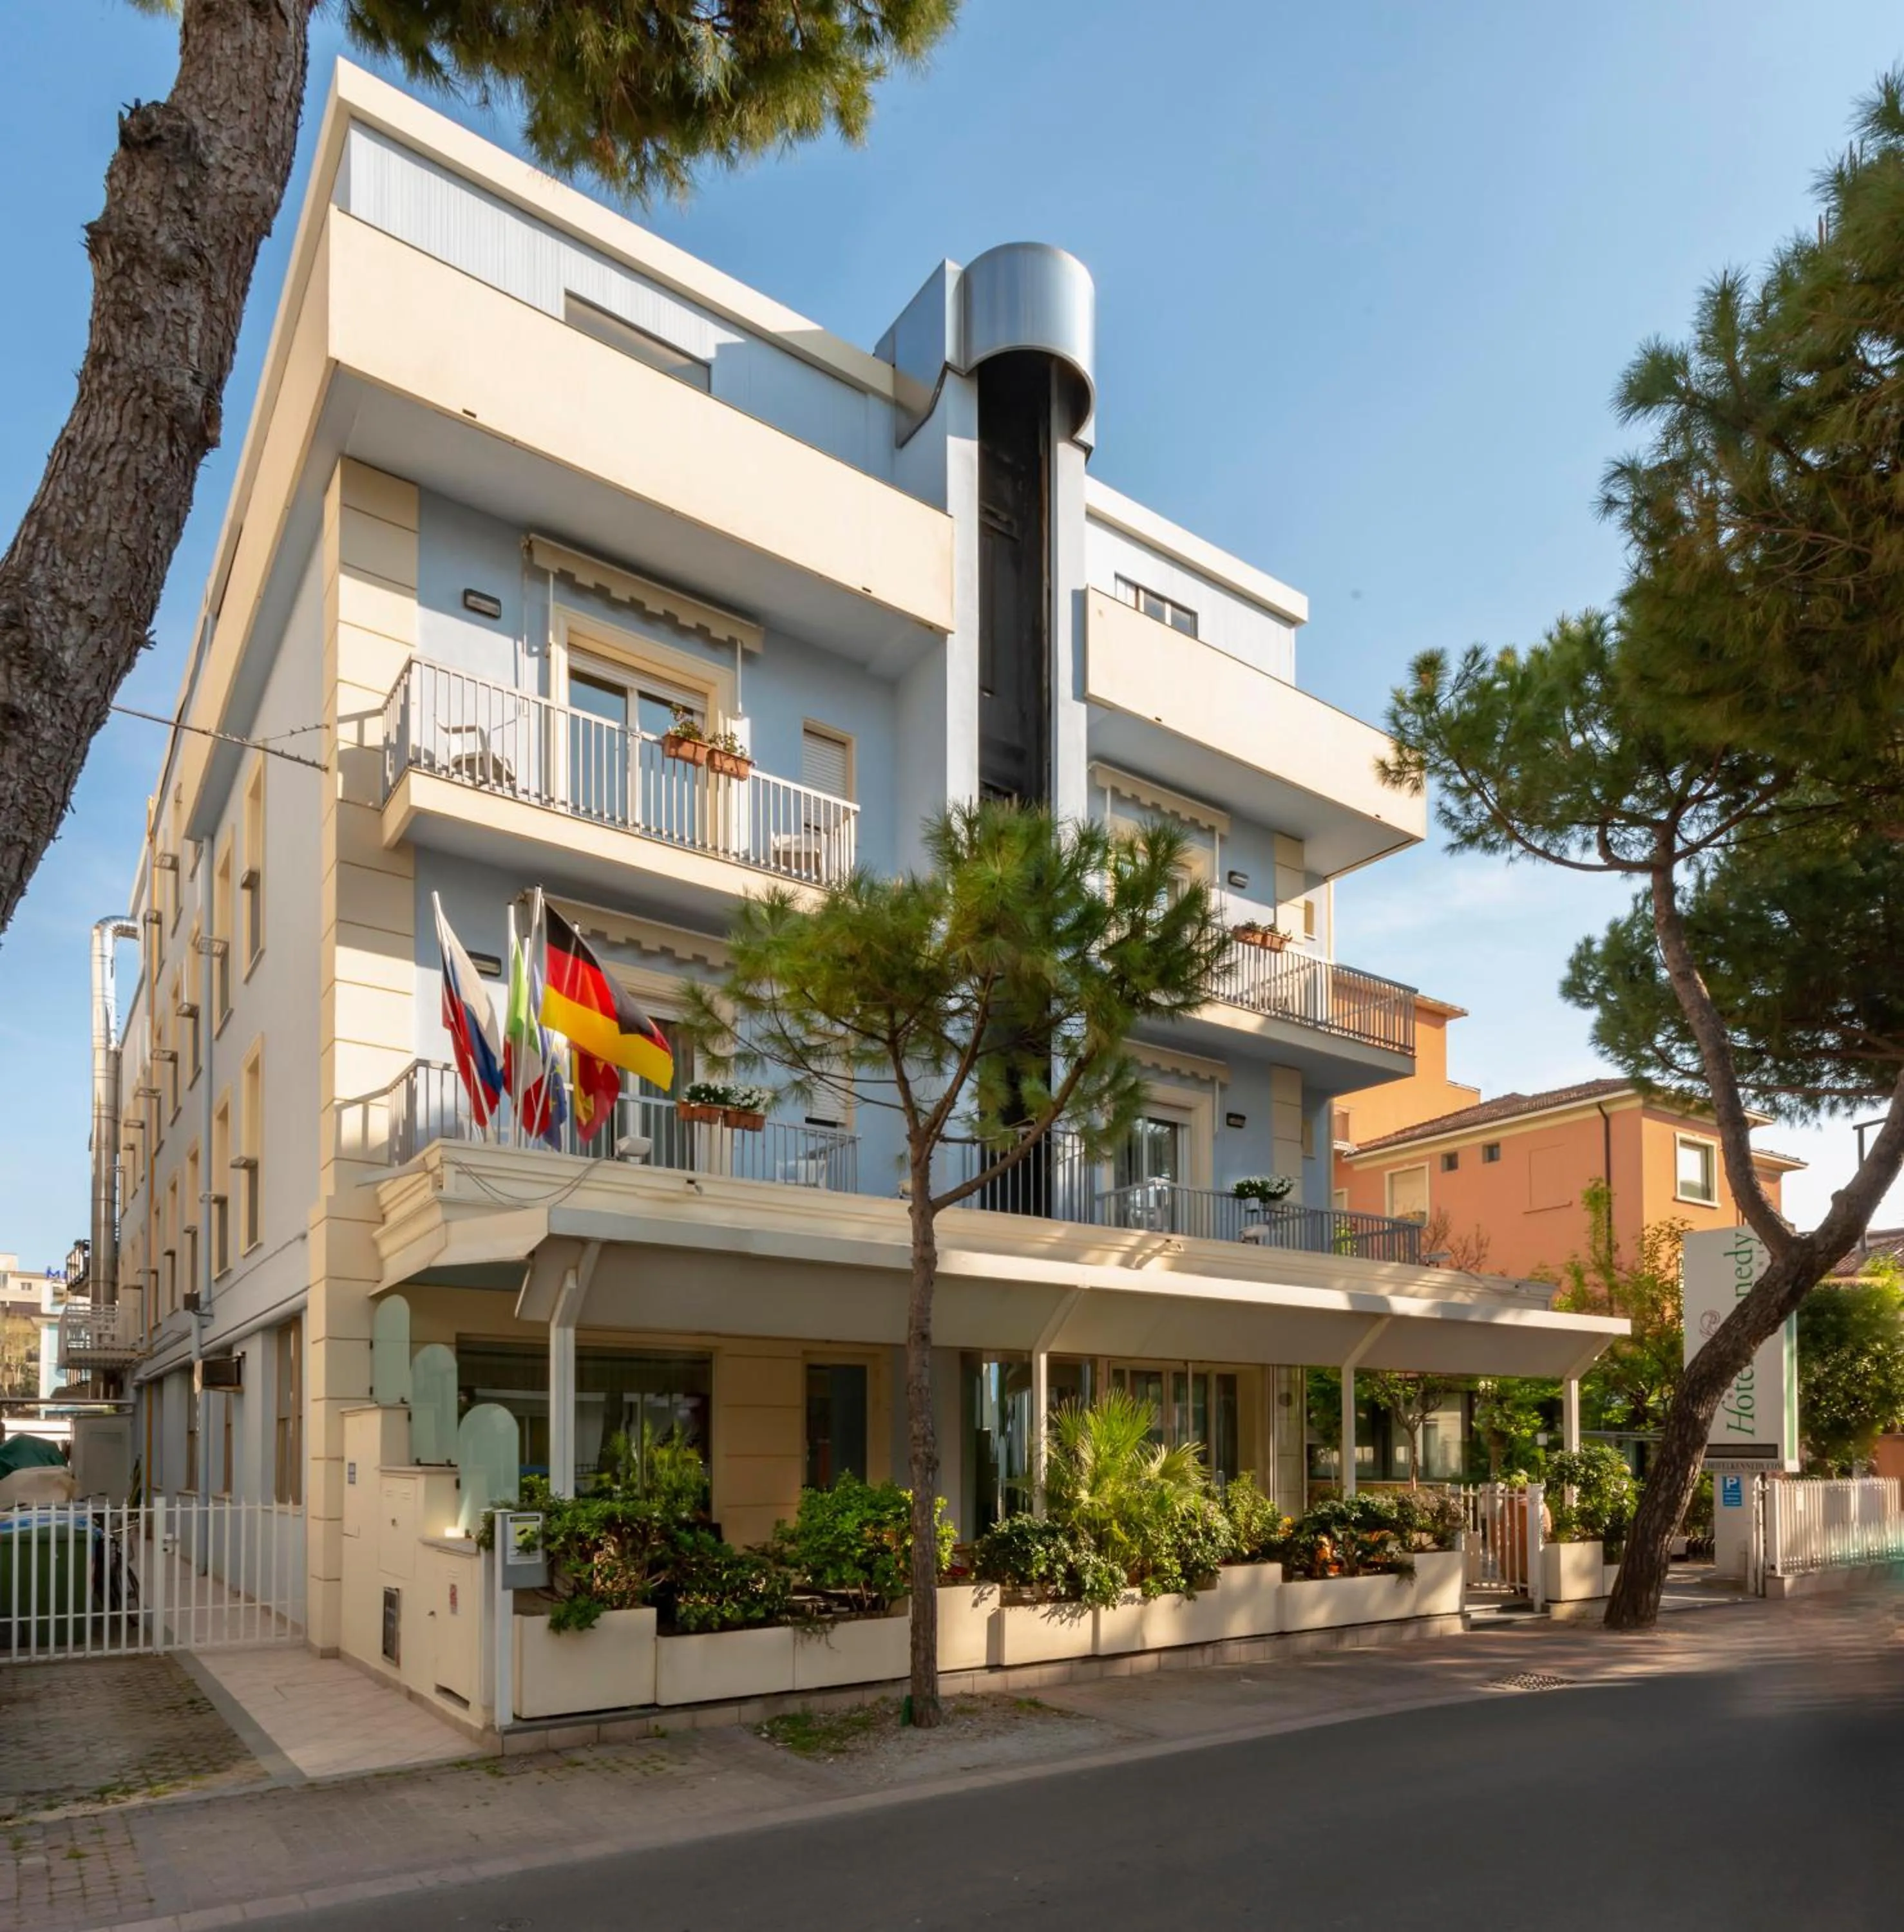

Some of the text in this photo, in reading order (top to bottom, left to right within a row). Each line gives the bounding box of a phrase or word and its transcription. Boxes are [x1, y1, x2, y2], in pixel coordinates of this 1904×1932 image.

[1722, 1232, 1763, 1437] Hote nedy
[1726, 1477, 1738, 1489] P
